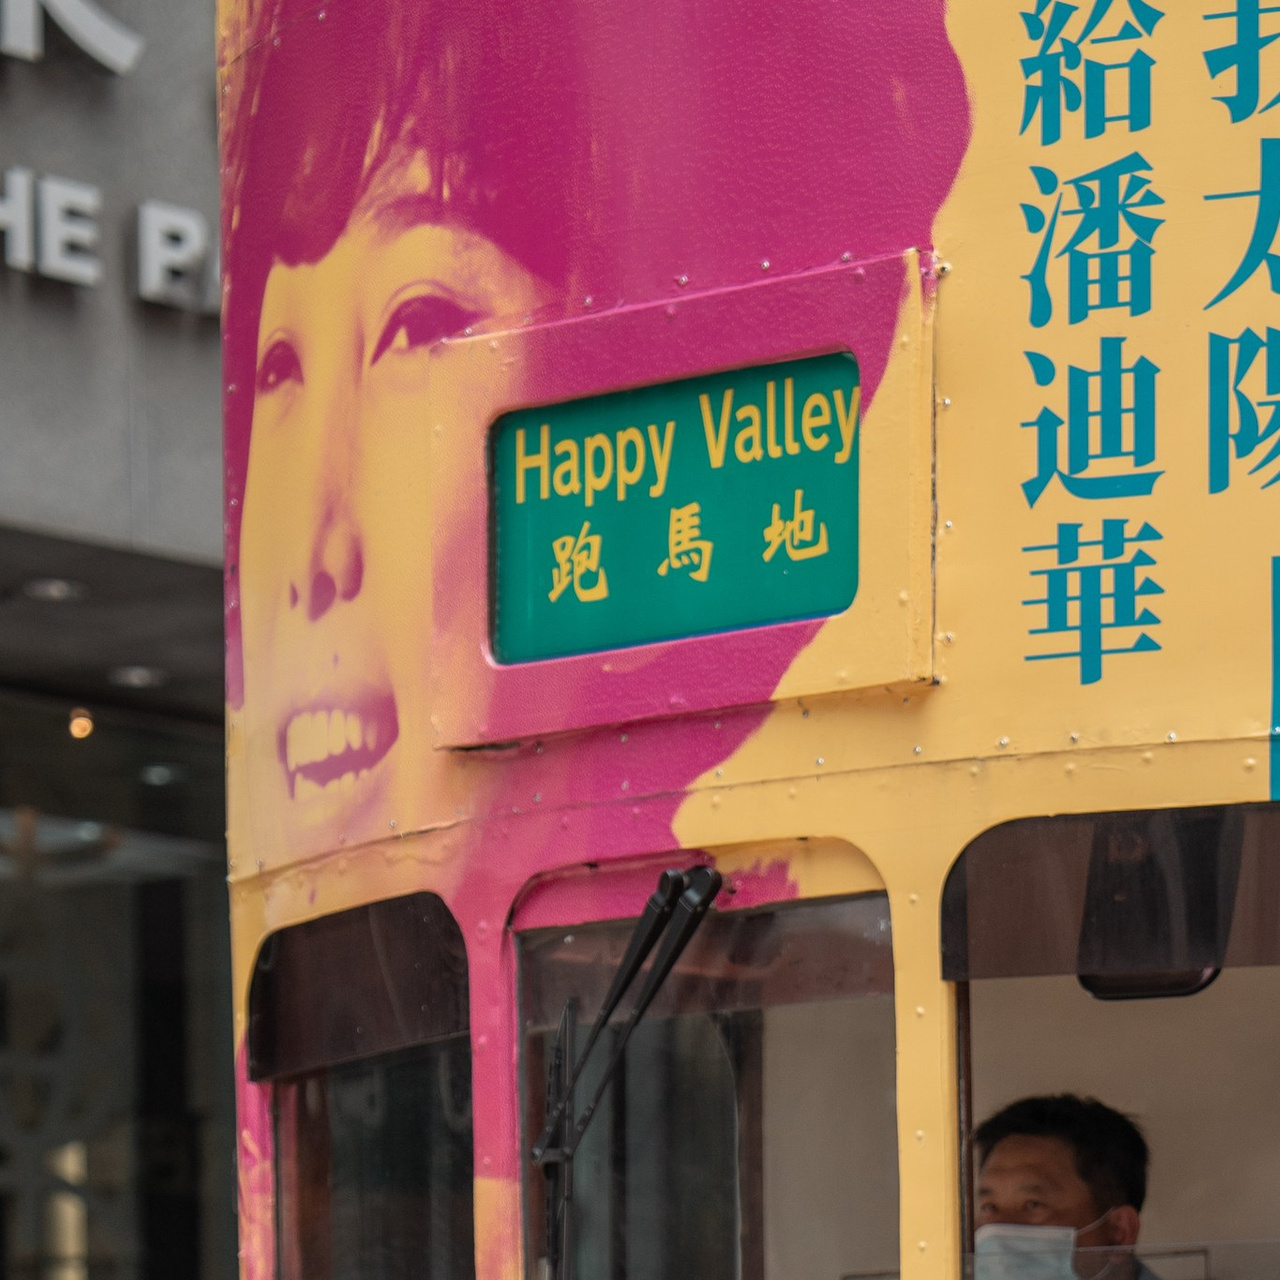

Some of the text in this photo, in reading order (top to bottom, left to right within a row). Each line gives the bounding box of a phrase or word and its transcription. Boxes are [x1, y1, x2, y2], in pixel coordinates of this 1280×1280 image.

[515, 377, 860, 507] Happy Valley
[548, 489, 829, 603] 跑馬地
